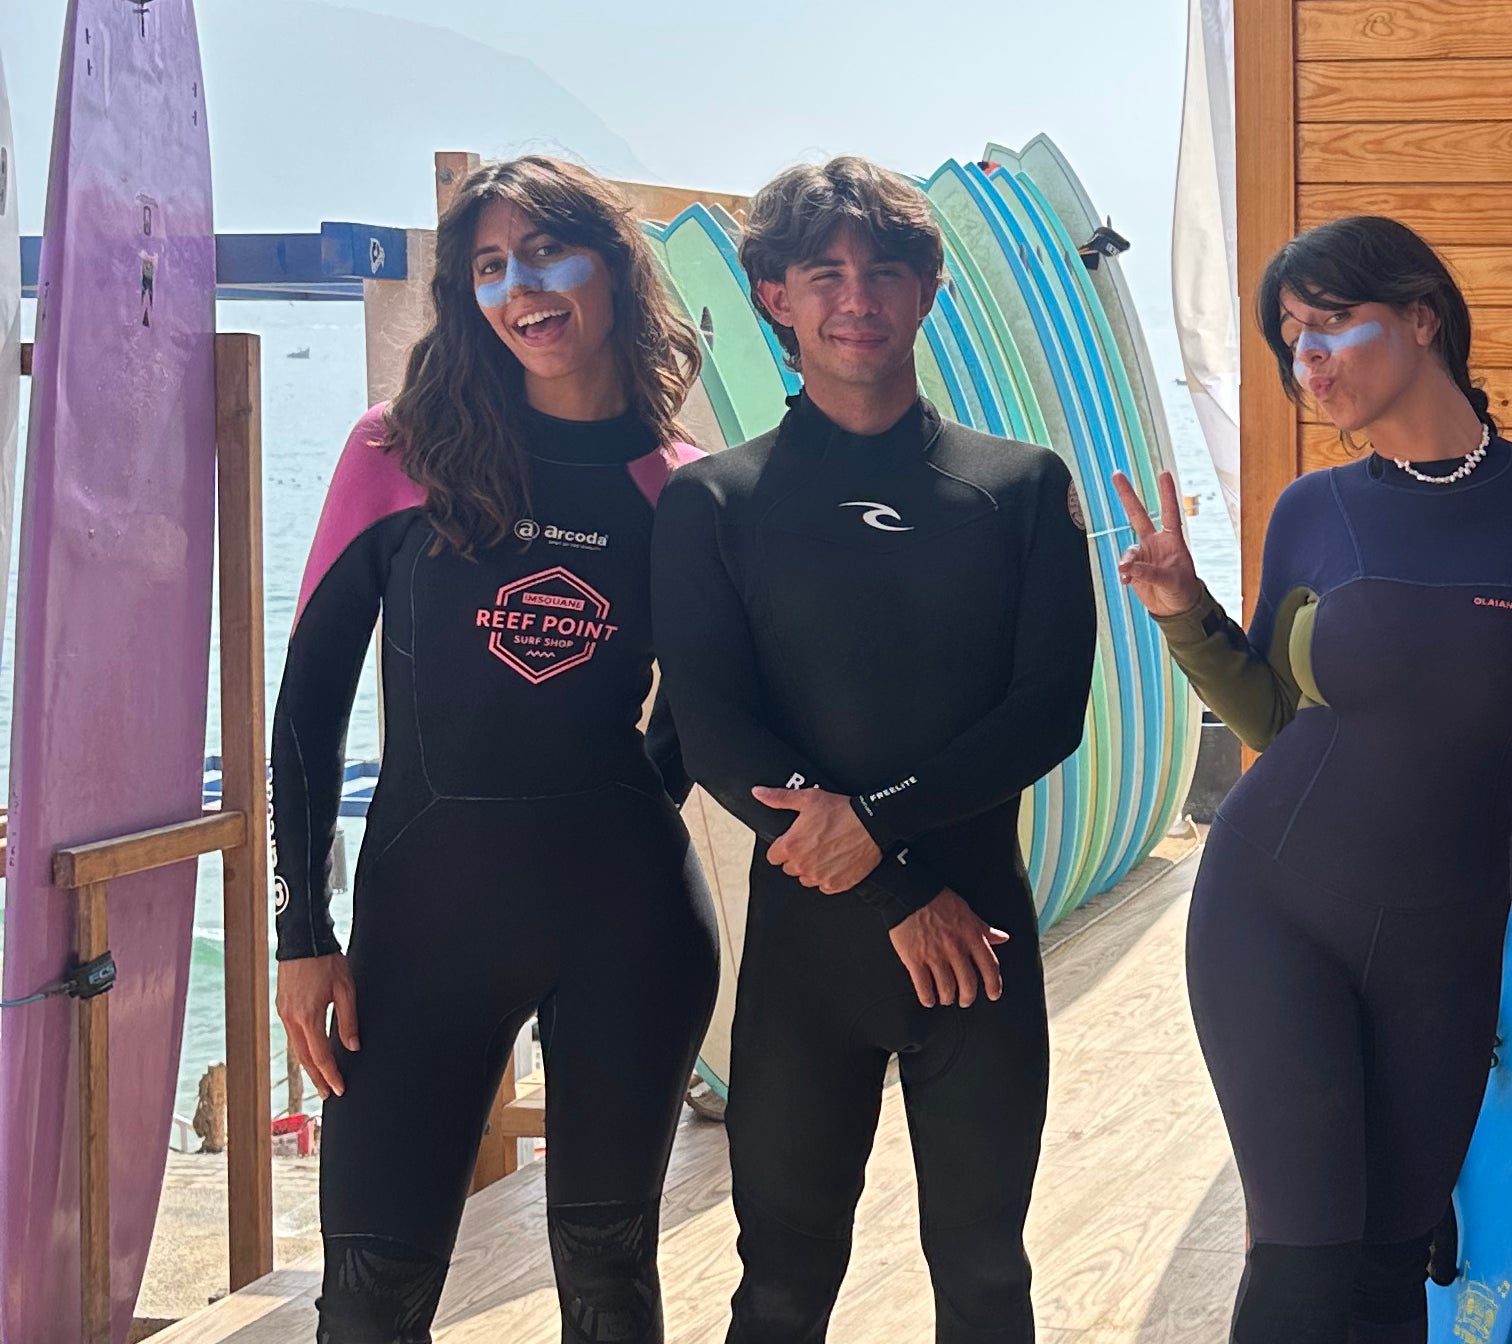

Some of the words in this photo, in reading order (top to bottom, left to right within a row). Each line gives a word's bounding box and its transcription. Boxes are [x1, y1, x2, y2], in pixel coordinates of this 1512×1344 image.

[544, 524, 608, 547] arcoda
[476, 609, 536, 631] REEF
[542, 615, 618, 642] POINT
[513, 634, 542, 646] SURF
[544, 637, 574, 649] SHOP
[869, 776, 917, 802] FREELITE
